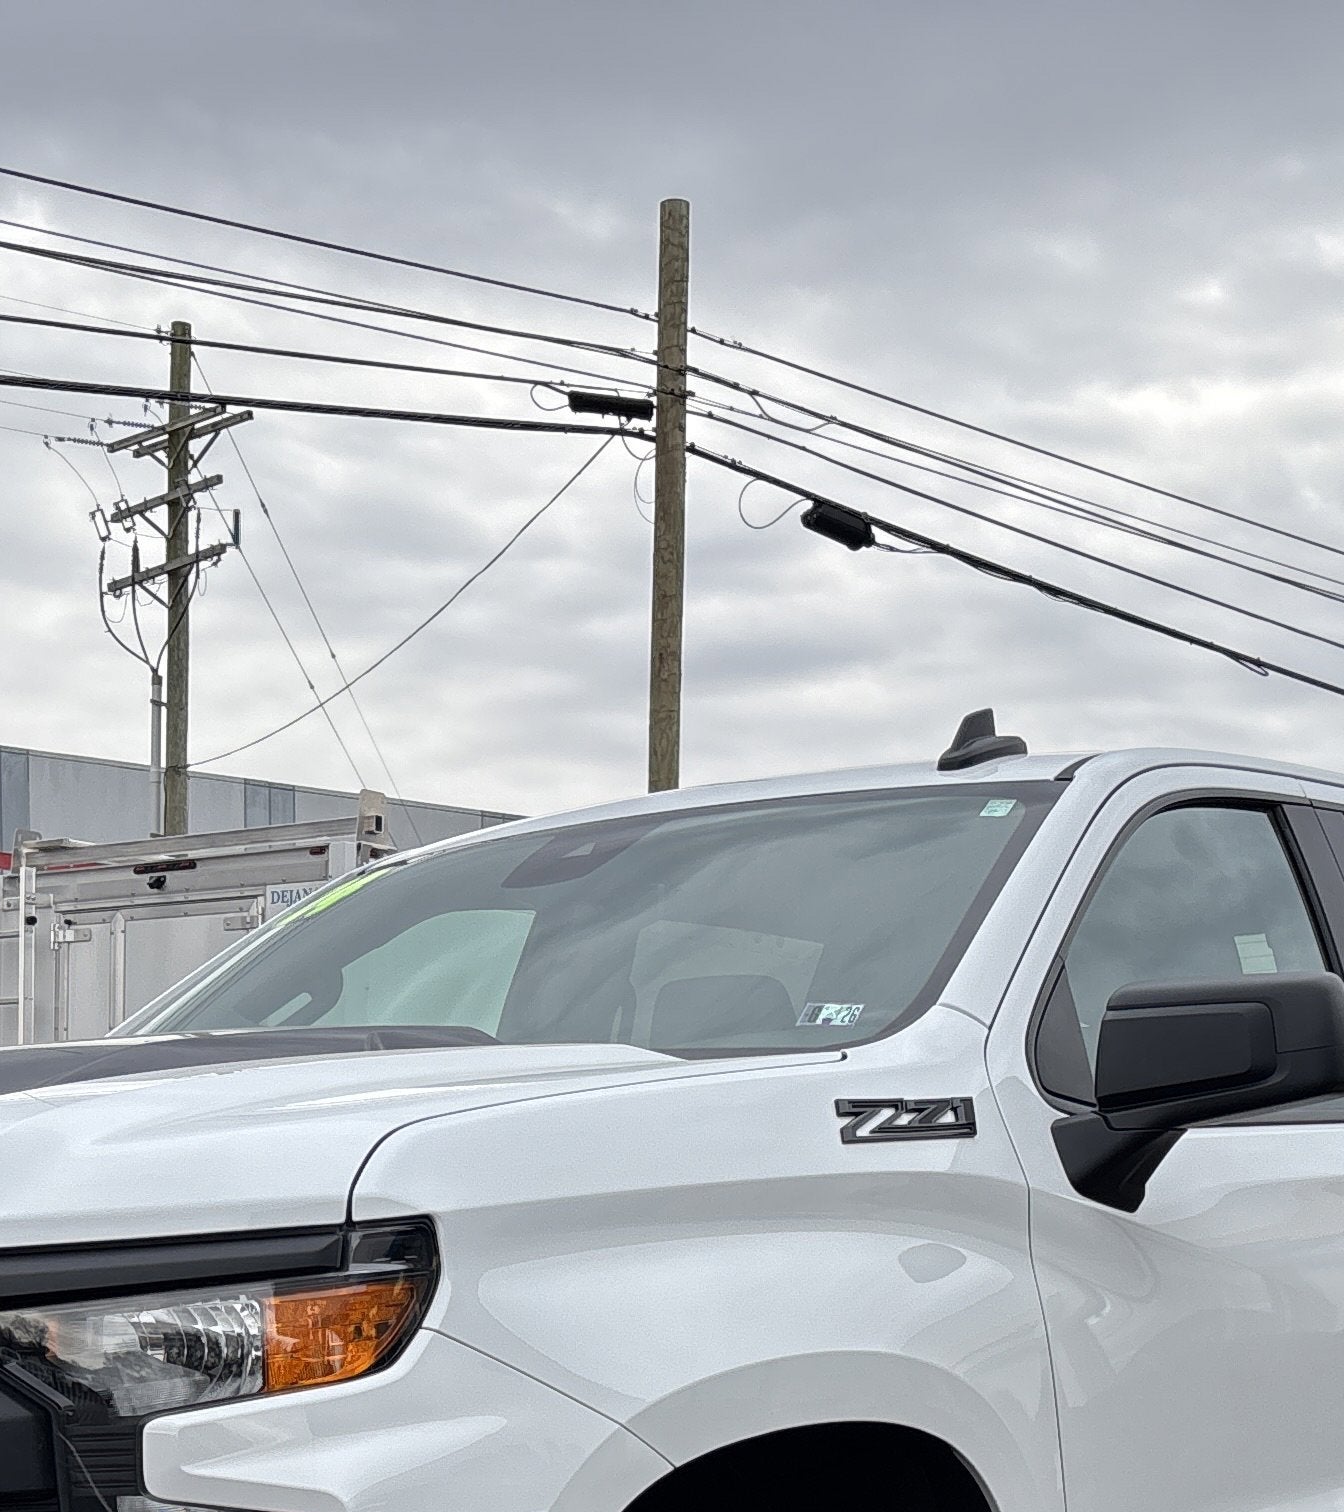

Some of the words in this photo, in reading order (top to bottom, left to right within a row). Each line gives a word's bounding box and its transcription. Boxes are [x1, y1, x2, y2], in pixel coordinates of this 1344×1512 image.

[270, 887, 317, 907] DEJAN
[840, 1006, 861, 1023] 26
[834, 1097, 977, 1144] Z71
